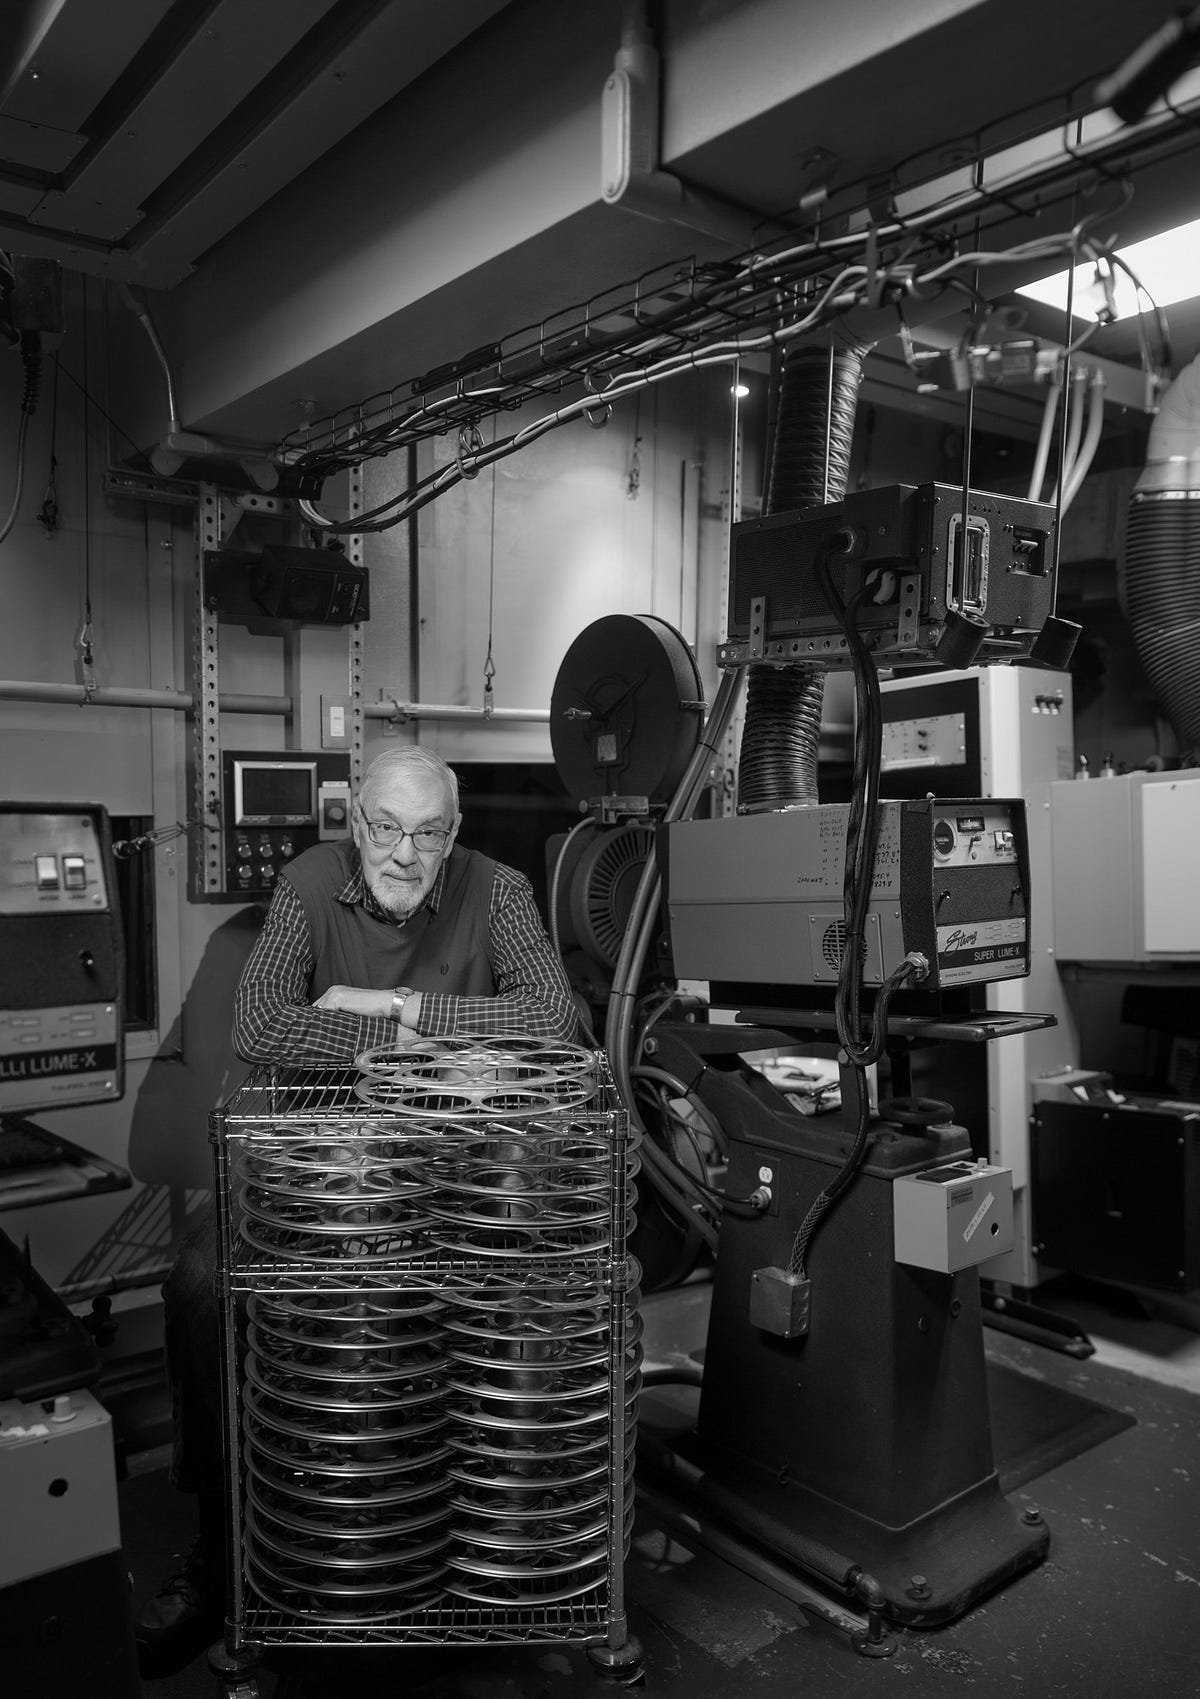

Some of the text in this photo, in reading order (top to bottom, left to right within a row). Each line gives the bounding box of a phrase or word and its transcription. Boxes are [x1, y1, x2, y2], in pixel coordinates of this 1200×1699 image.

[944, 929, 978, 956] Strong
[974, 946, 1020, 961] SUPER LUME-X
[29, 1051, 97, 1075] LUME-X
